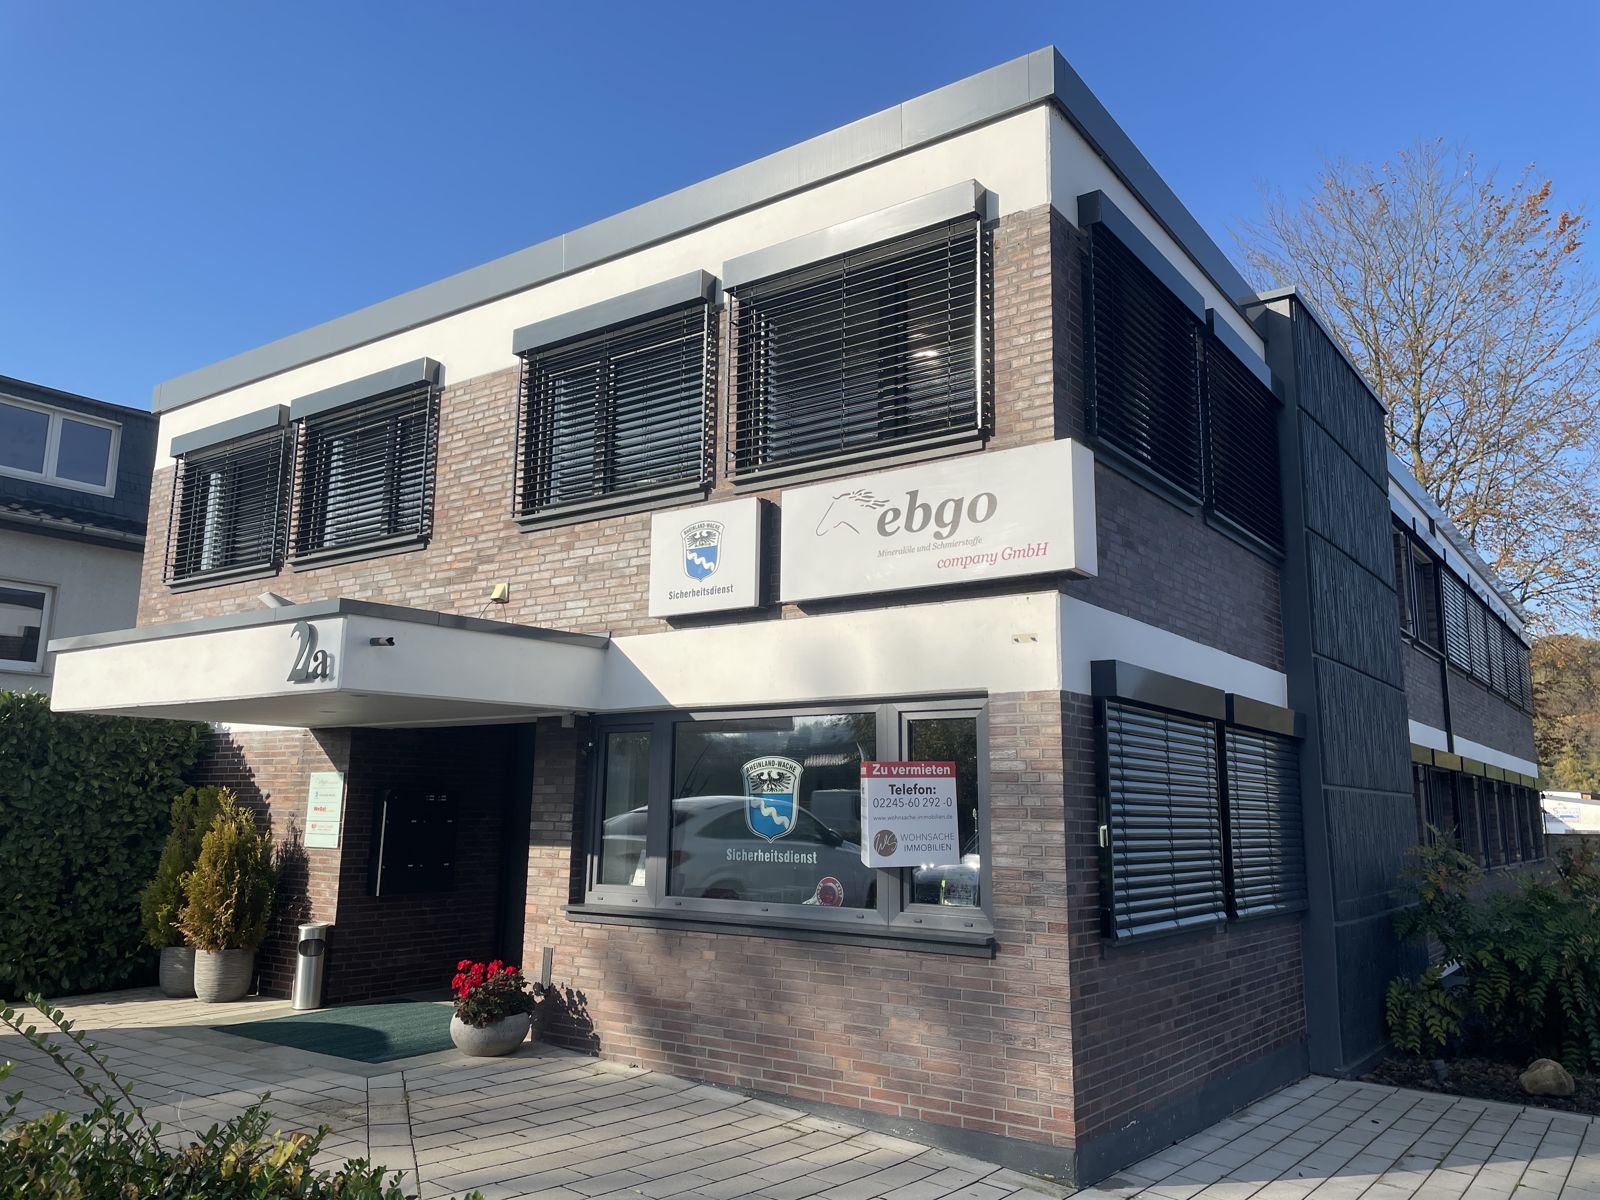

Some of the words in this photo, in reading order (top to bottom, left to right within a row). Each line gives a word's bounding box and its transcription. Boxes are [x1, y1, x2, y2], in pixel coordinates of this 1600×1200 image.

[877, 489, 998, 540] ebgo
[683, 522, 722, 535] RHEINLAND-WACHE
[877, 546, 916, 558] Mineralöle
[916, 543, 931, 553] und
[932, 536, 983, 551] Schmierstoffe
[937, 552, 999, 569] company
[1001, 542, 1049, 561] GmbH
[668, 583, 734, 600] Sicherheitsdienst
[287, 620, 330, 682] 2a
[745, 759, 797, 773] RHEINLAND-WACHE
[872, 763, 888, 775] Zu
[891, 763, 951, 775] vermieten
[888, 783, 936, 795] Telefon:
[872, 797, 920, 808] 02245-60
[922, 797, 940, 808] 292
[900, 832, 955, 841] WOHNSACHE
[903, 843, 952, 852] IMMOBILIEN
[726, 848, 817, 864] Sicherheitsdienst
